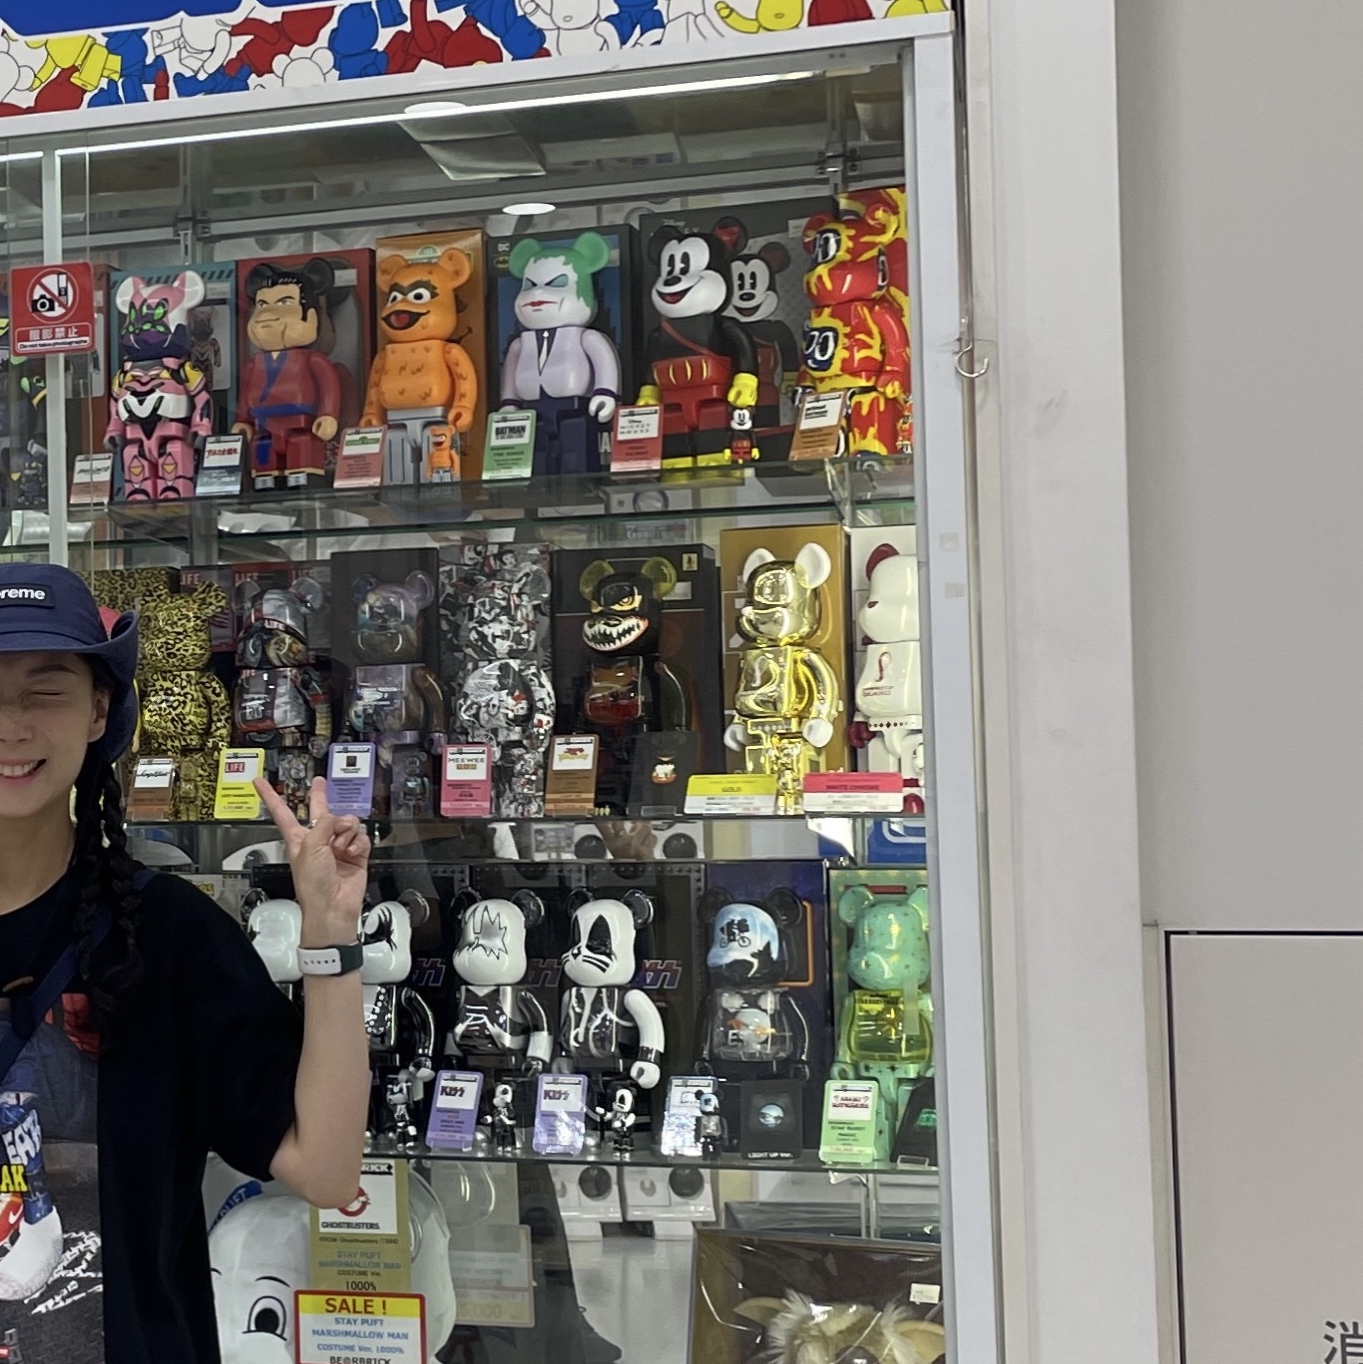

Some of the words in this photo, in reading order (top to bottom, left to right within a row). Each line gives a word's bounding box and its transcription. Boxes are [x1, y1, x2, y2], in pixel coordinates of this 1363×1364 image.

[495, 426, 526, 436] BATMAN
[225, 762, 245, 773] LIFE
[440, 1085, 465, 1098] KISS
[543, 1089, 569, 1101] KISS
[321, 1222, 380, 1230] GHOSTBUSTERS
[337, 1250, 357, 1259] STAY
[360, 1251, 382, 1259] PUFT
[319, 1260, 381, 1269] MARSHMALLOW
[383, 1262, 402, 1270] MAN
[345, 1280, 377, 1292] 1000%
[325, 1297, 376, 1315] SALE
[381, 1300, 388, 1314] !
[334, 1317, 357, 1326] STAY
[360, 1318, 385, 1327] PUFT
[312, 1329, 383, 1339] MARSHMALLOW
[387, 1331, 409, 1340] MAN
[317, 1343, 354, 1352] COSTUME
[358, 1345, 373, 1353] Ver.
[375, 1346, 404, 1354] 1000%
